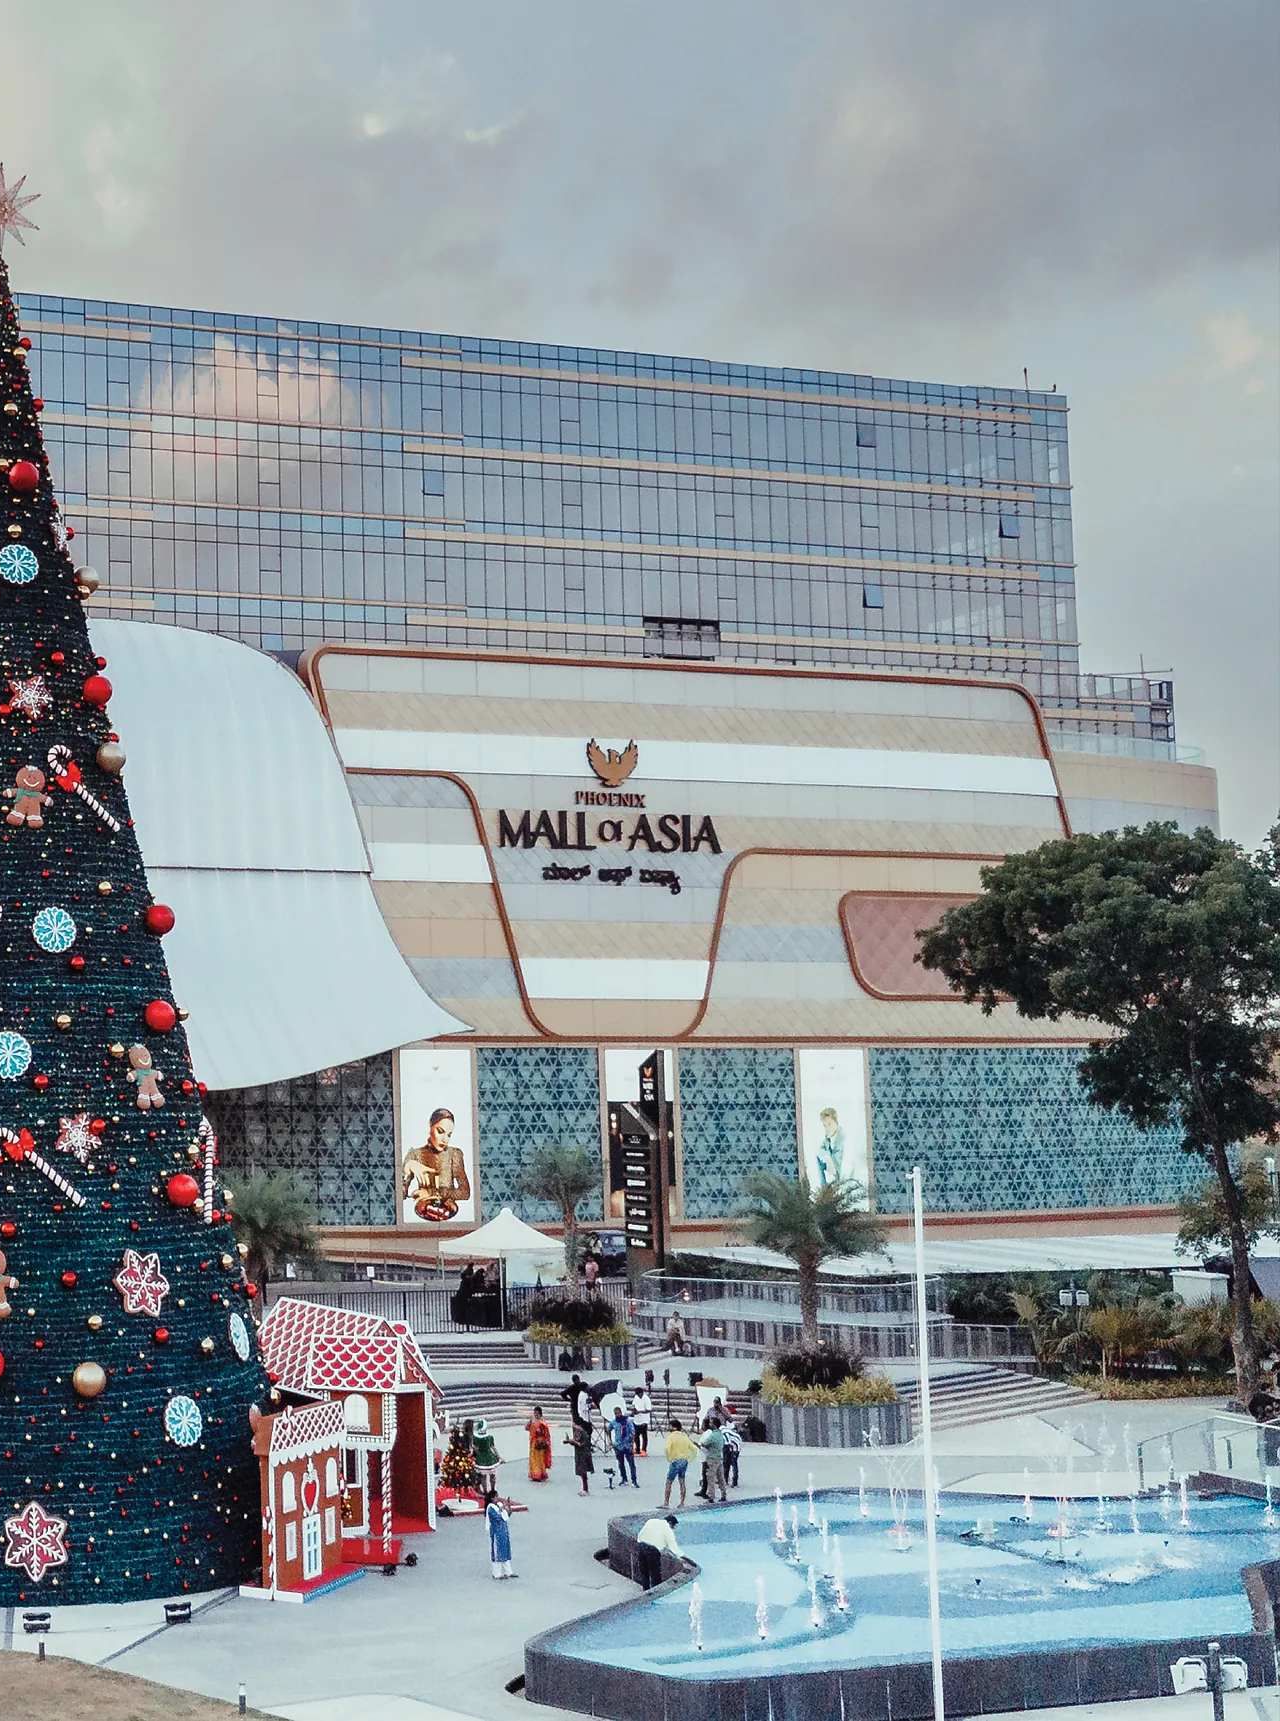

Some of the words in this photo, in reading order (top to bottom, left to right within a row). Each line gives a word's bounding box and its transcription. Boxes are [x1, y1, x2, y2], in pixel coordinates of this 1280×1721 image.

[575, 791, 646, 808] PHOENIX
[499, 809, 597, 851] MALL
[628, 814, 723, 855] ASIA
